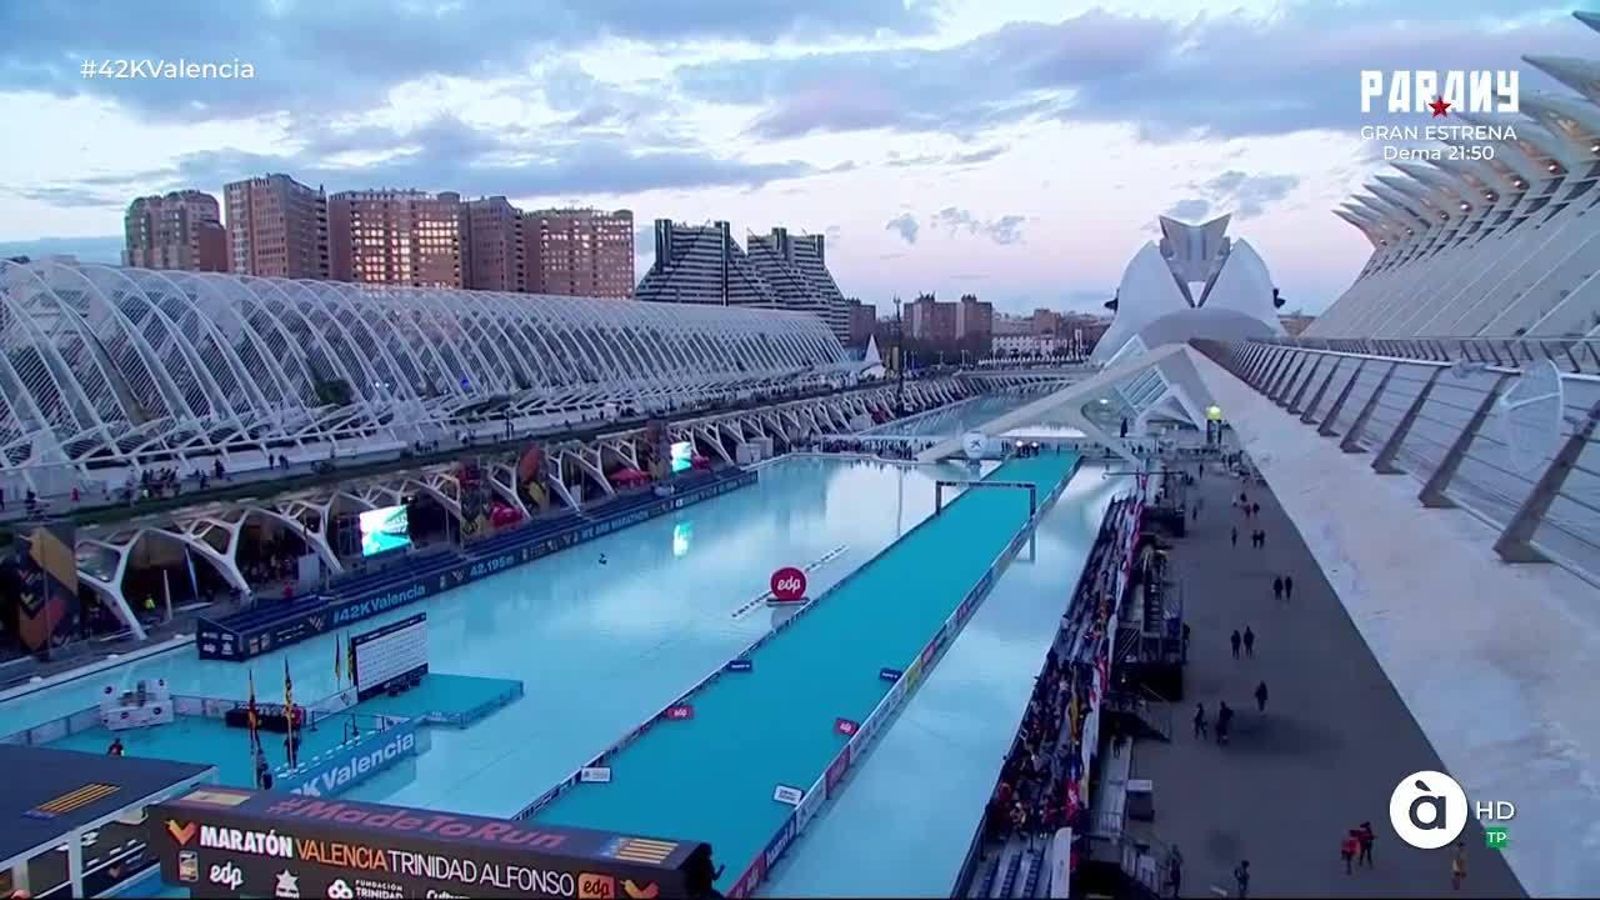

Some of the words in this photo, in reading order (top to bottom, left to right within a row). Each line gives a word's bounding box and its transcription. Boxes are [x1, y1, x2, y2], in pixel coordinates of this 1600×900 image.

[777, 576, 801, 594] edp
[200, 825, 293, 858] MARATÓN
[296, 839, 388, 871] VALENCIA
[387, 850, 477, 883] TRINIDAD
[480, 863, 575, 896] ALFONSO
[210, 861, 243, 891] edp
